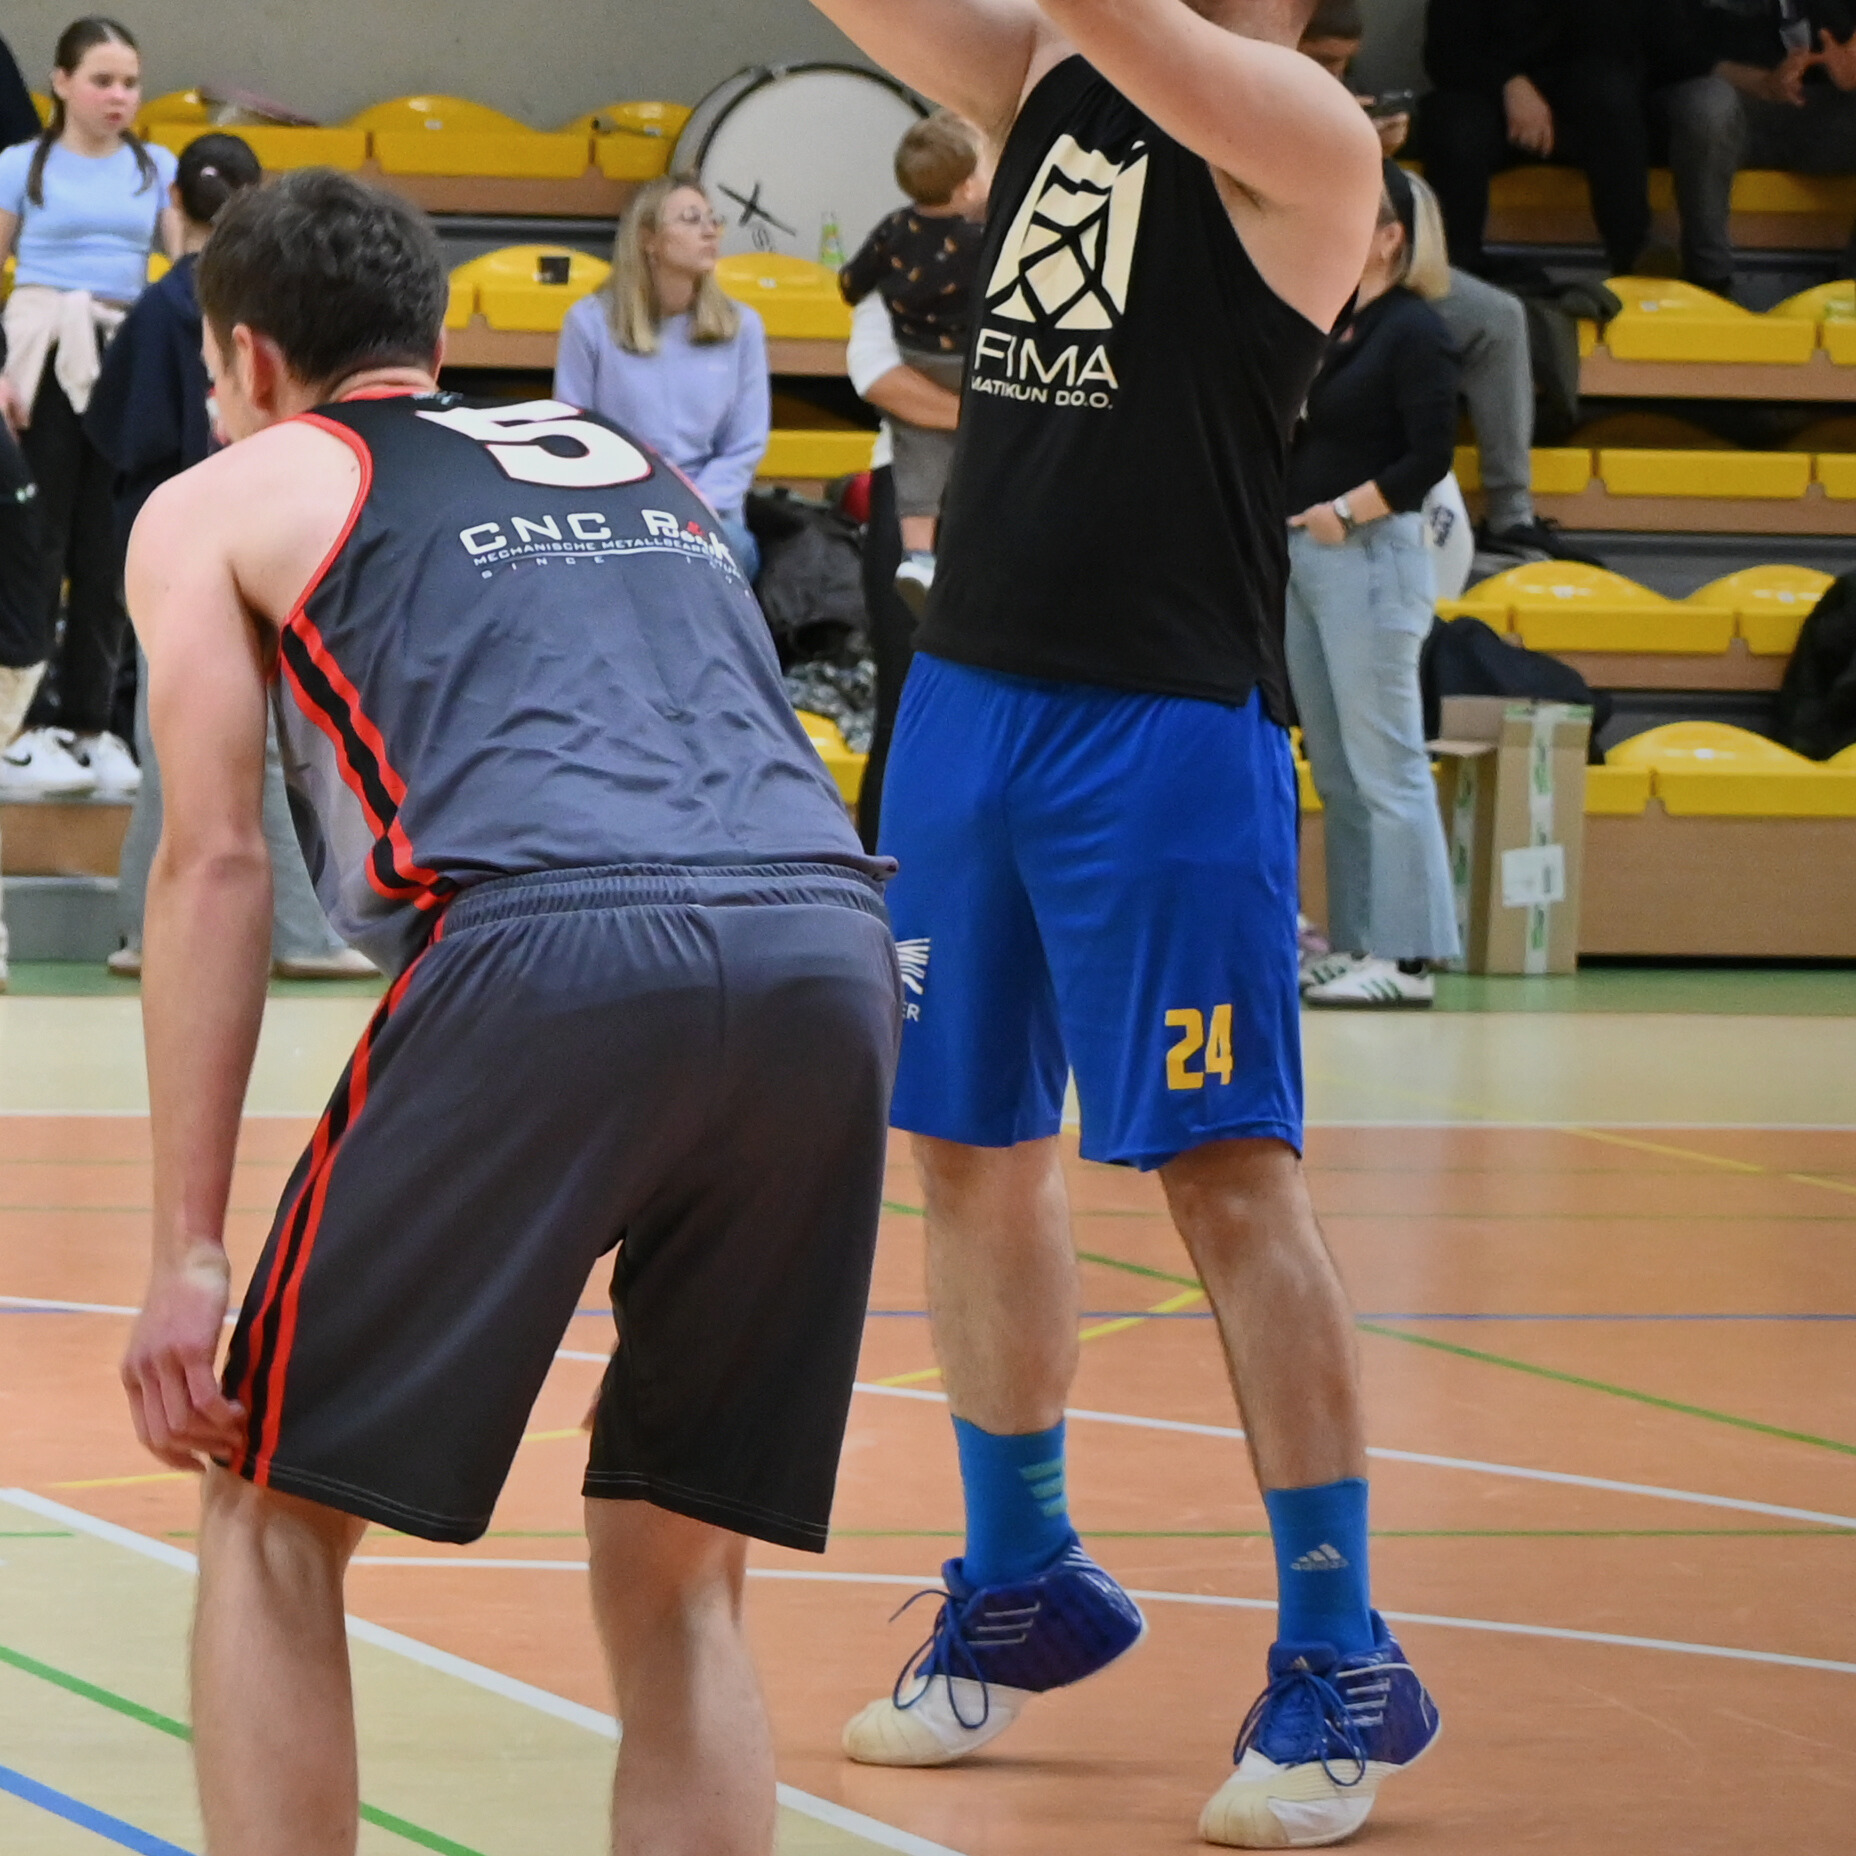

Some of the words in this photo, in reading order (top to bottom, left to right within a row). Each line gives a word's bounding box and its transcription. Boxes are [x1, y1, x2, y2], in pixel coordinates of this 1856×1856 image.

[974, 328, 1119, 390] FIMA
[414, 399, 652, 488] 5
[459, 512, 612, 556] CNC
[473, 542, 596, 566] MECHANISCHE
[1165, 1003, 1233, 1091] 24
